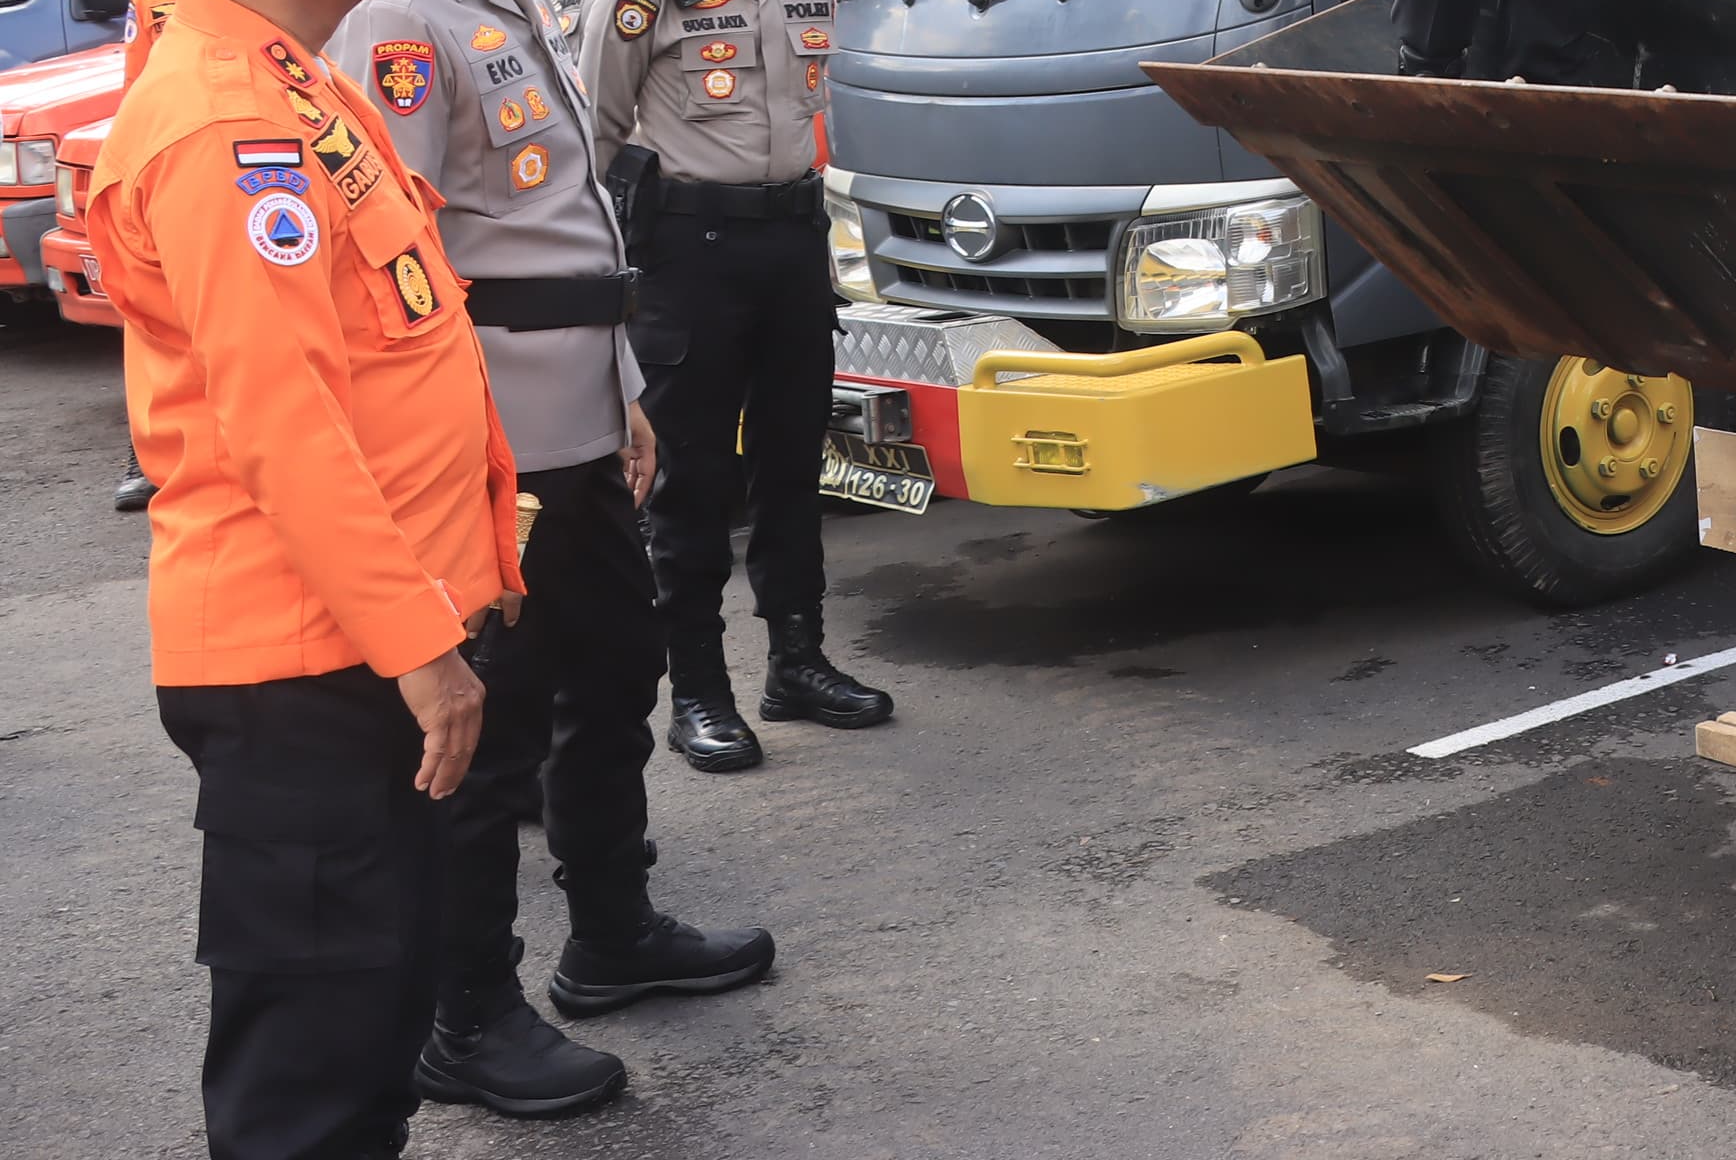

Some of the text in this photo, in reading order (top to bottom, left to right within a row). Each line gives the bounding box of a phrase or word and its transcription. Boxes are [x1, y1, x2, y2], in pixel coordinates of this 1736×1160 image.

[784, 2, 830, 19] POLRI
[682, 14, 748, 33] SUGI JAYA
[377, 43, 430, 55] PROPAM
[486, 55, 524, 85] EKO
[247, 170, 301, 187] BPBD
[863, 444, 910, 471] XXI
